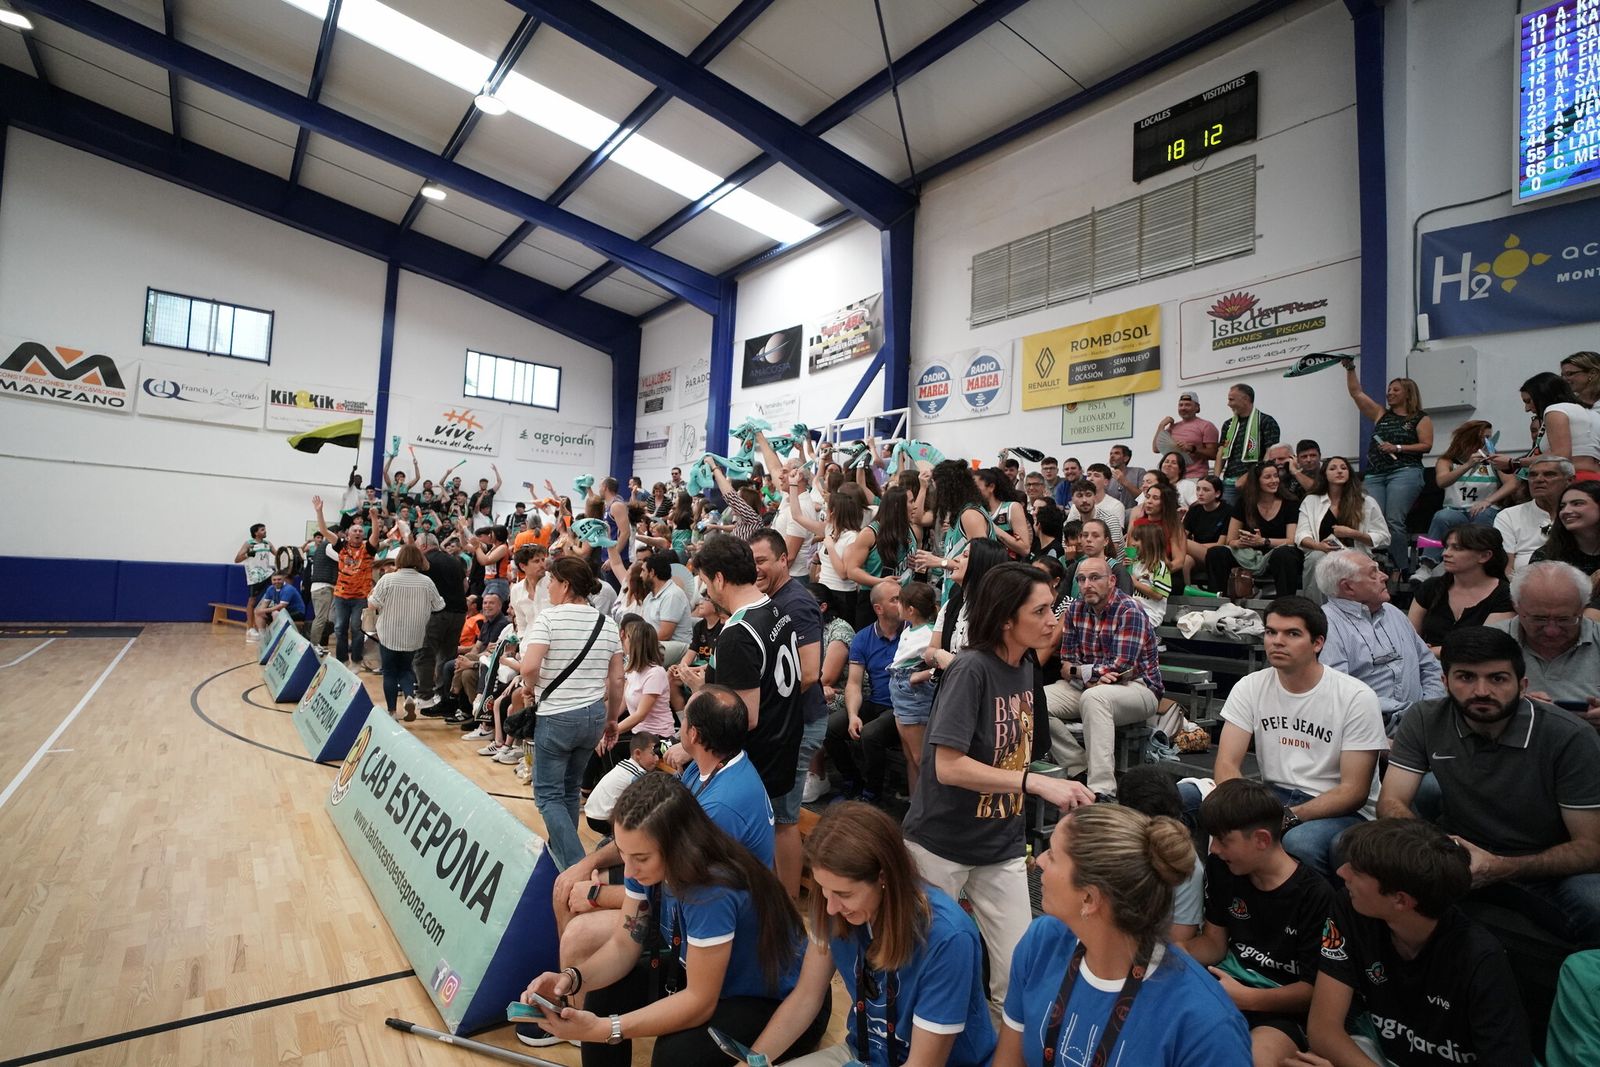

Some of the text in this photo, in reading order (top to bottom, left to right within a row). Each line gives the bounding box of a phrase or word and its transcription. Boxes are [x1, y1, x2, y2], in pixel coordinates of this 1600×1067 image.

[1529, 13, 1547, 31] 10
[1556, 6, 1571, 21] A.
[1529, 43, 1547, 60] 12
[1577, 24, 1600, 42] SA
[1530, 28, 1545, 45] 11
[1556, 20, 1571, 36] N.
[1528, 37, 1600, 75] 13 M. EF
[1528, 72, 1546, 89] 14
[1555, 64, 1573, 80] M.
[1528, 68, 1600, 105] 19 A. SA
[1203, 76, 1247, 101] VISITANTES
[1527, 84, 1600, 119] 22 A. HA
[1140, 109, 1171, 128] LOCALES
[1527, 117, 1546, 133] 33
[1554, 111, 1569, 126] A.
[1204, 123, 1223, 147] 12
[1526, 131, 1546, 147] 44
[1553, 126, 1568, 140] S.
[1168, 138, 1185, 161] 18
[1527, 146, 1546, 163] 55
[1526, 161, 1546, 178] 66
[1553, 155, 1568, 170] C.
[1531, 176, 1542, 191] 0
[1071, 325, 1152, 352] ROMBOSOL
[1213, 332, 1263, 349] JARDINES
[1275, 319, 1325, 336] PISCINAS
[970, 361, 997, 375] RADIO
[1075, 363, 1097, 373] NUEVO
[1113, 352, 1150, 366] SEMINUEVO
[923, 371, 948, 384] RADIO
[966, 373, 999, 391] MARCA
[1028, 378, 1060, 390] RENAULT
[1074, 371, 1104, 381] OCASIÓN
[0, 380, 125, 407] MANZANO
[181, 383, 209, 394] Francis
[918, 382, 949, 399] MARCA
[1087, 400, 1107, 411] PISTA
[1078, 411, 1116, 423] LEONARDO
[533, 432, 594, 447] agrojardín
[1070, 421, 1125, 436] TORRES BENÍTEZ
[424, 437, 448, 446] marca
[462, 443, 493, 453] deporte
[1459, 487, 1479, 502] 14
[329, 677, 347, 700] CAB
[310, 692, 340, 734] ESTEPONA
[1293, 718, 1333, 743] JEANS
[361, 745, 505, 925] CAB ESTEPONA
[353, 807, 446, 947] www.baloncestoestepona.com
